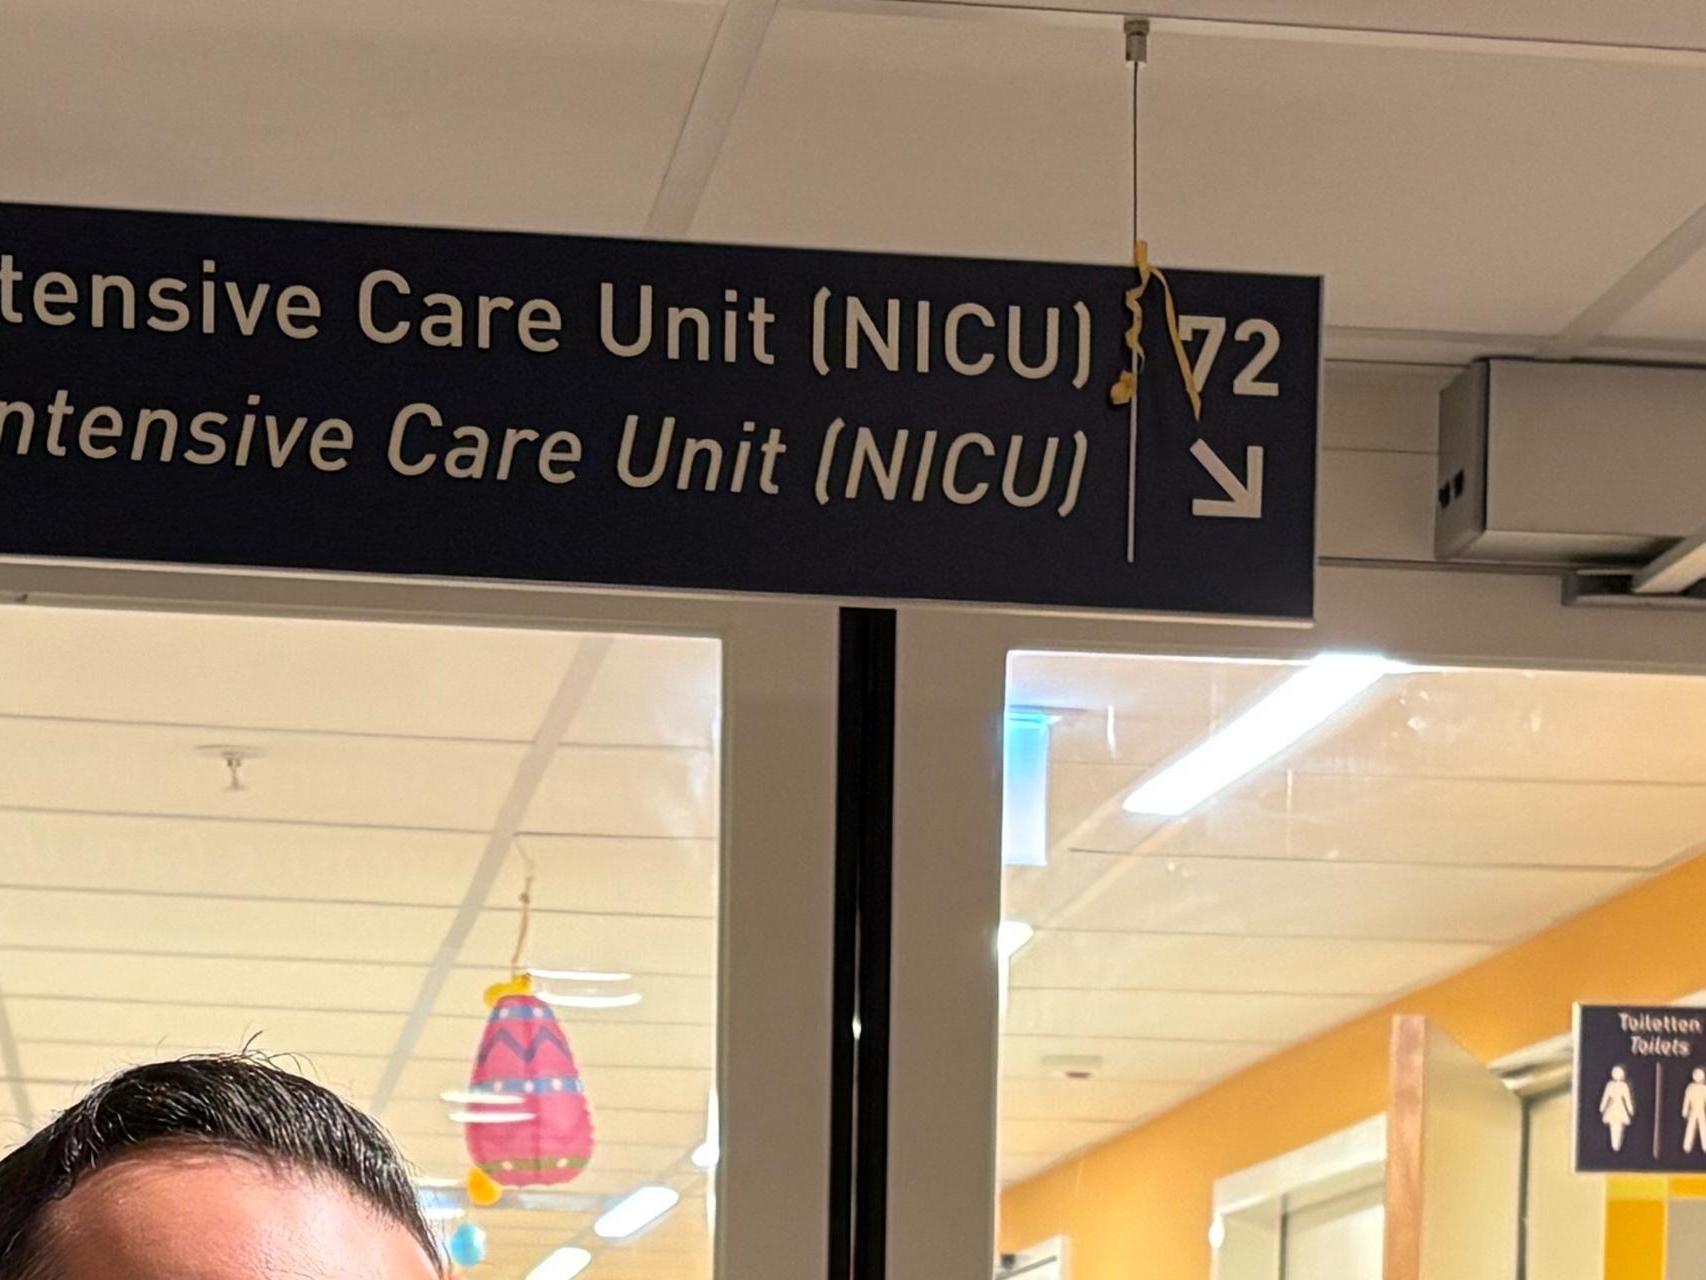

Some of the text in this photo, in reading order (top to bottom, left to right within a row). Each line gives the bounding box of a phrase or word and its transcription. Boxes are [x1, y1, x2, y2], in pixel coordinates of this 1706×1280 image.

[357, 269, 562, 353] Care
[599, 282, 775, 366] Unit
[812, 286, 1091, 389] (NICU)
[1179, 314, 1281, 397] 72
[387, 402, 583, 485] Care
[616, 414, 787, 495] Unit
[814, 417, 1088, 517] (NICU)
[1618, 1012, 1702, 1034] Toiletten
[1630, 1035, 1692, 1057] Toilets
